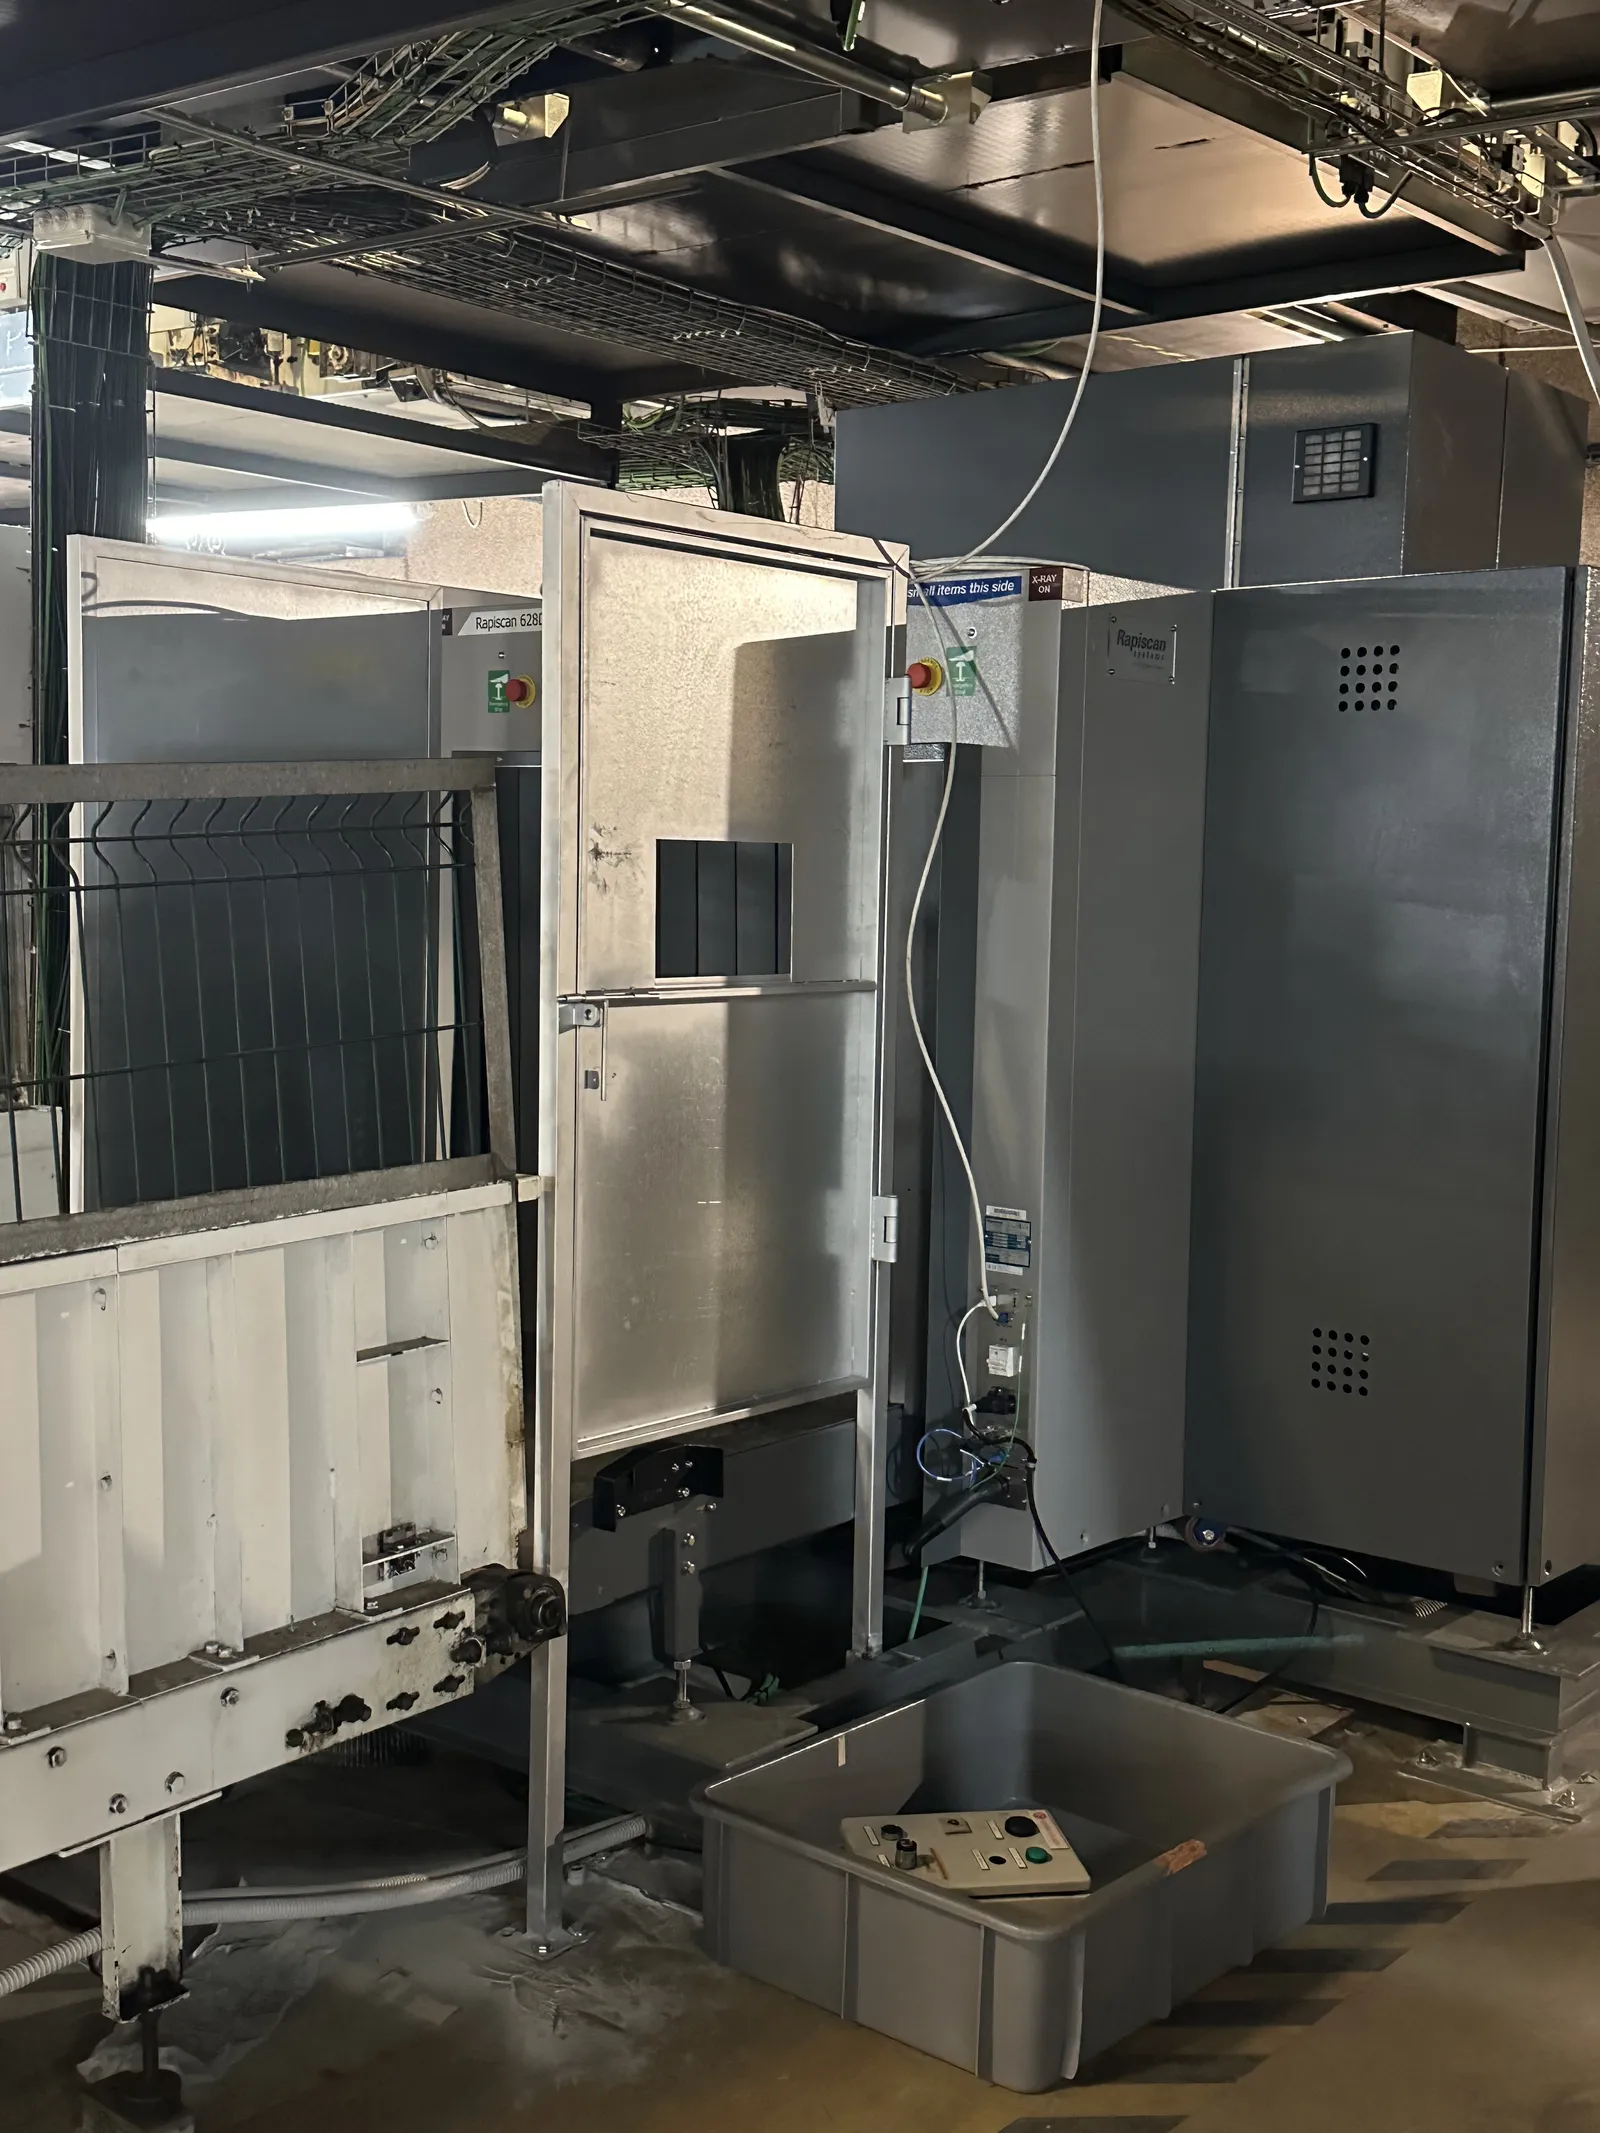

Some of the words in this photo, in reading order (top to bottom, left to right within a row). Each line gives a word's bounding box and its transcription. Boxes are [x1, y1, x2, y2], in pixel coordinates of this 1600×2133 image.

[1032, 574, 1057, 584] X-RAY
[937, 584, 967, 596] items
[969, 582, 989, 594] this
[992, 580, 1015, 592] side
[1038, 585, 1051, 594] ON
[475, 615, 517, 632] Rapiscan
[1116, 628, 1167, 652] Rapiscan
